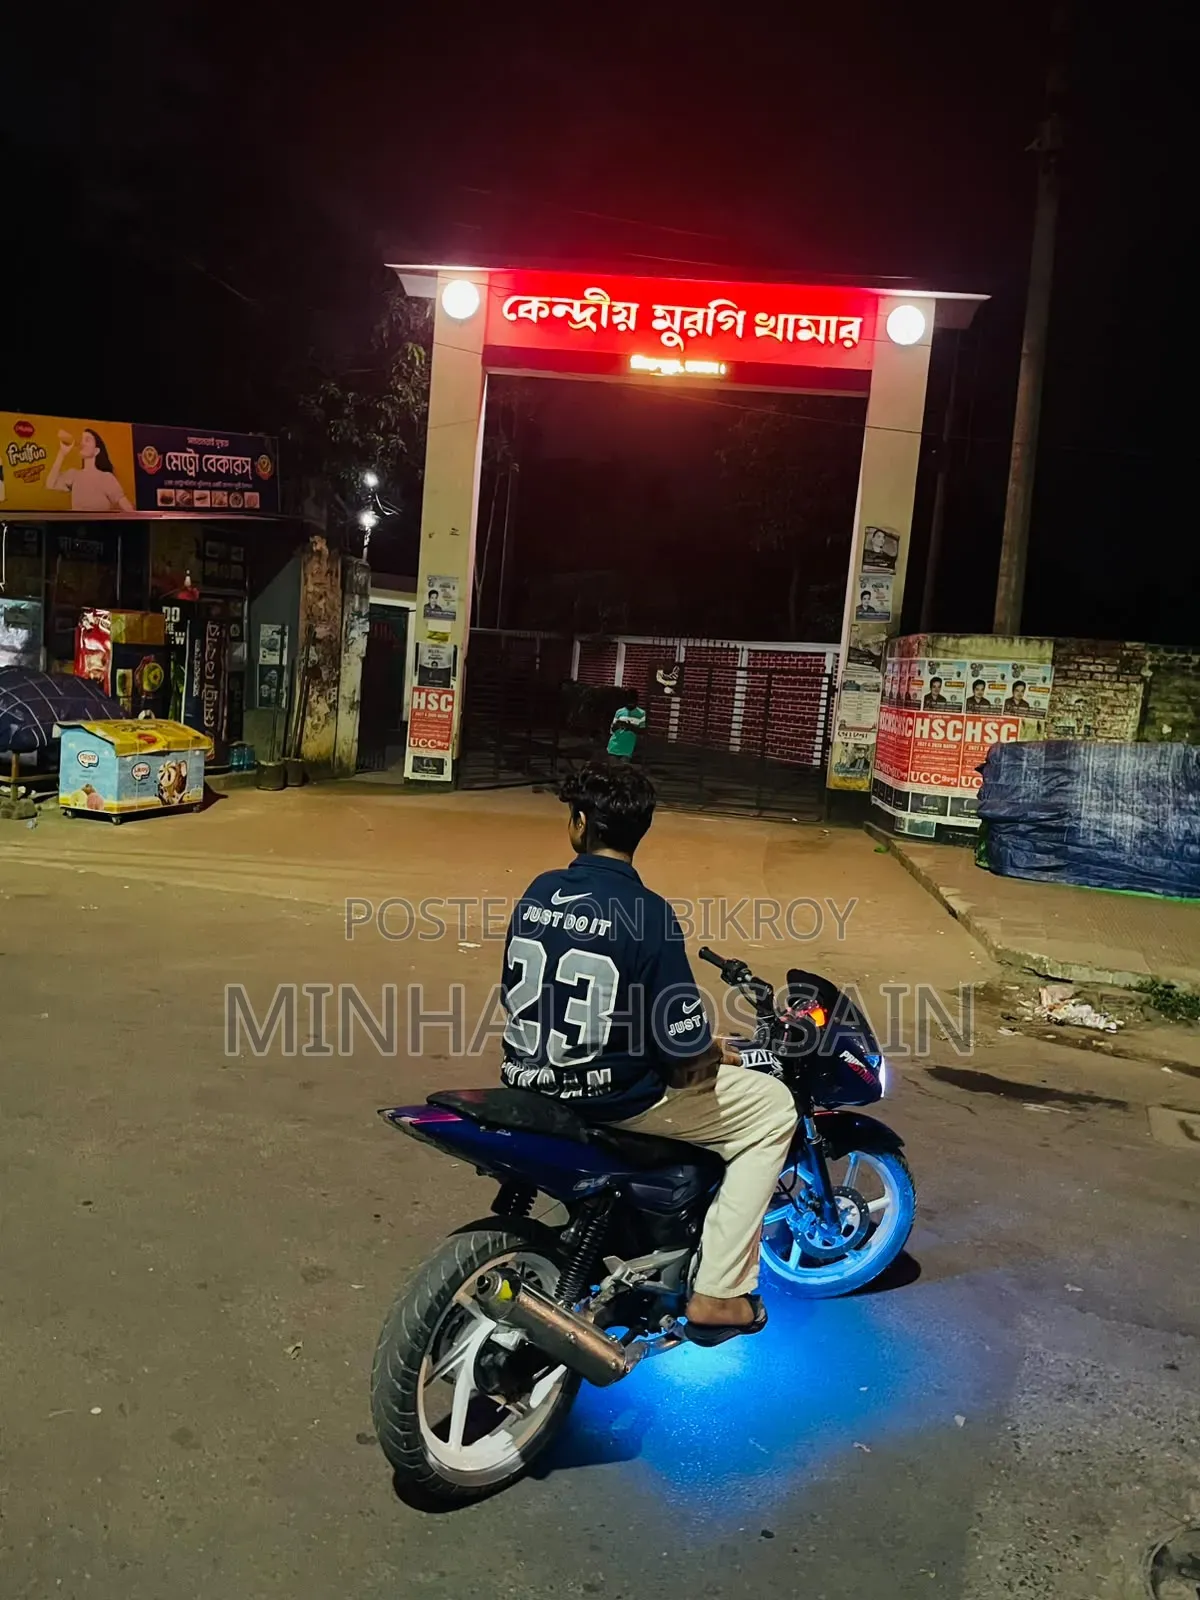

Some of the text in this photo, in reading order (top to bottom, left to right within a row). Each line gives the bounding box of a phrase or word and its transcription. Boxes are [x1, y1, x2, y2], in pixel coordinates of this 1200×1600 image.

[502, 286, 863, 353] কেন্দ্রীয় মুরগি খামার
[412, 691, 453, 712] HSC
[916, 717, 963, 742] HSC
[965, 720, 1017, 743] HSC
[409, 737, 437, 748] UCC
[910, 771, 942, 785] UCC
[961, 776, 983, 788] UC
[522, 905, 612, 937] JUST DO IT
[503, 936, 620, 1067] 23
[667, 1015, 701, 1037] JUST
